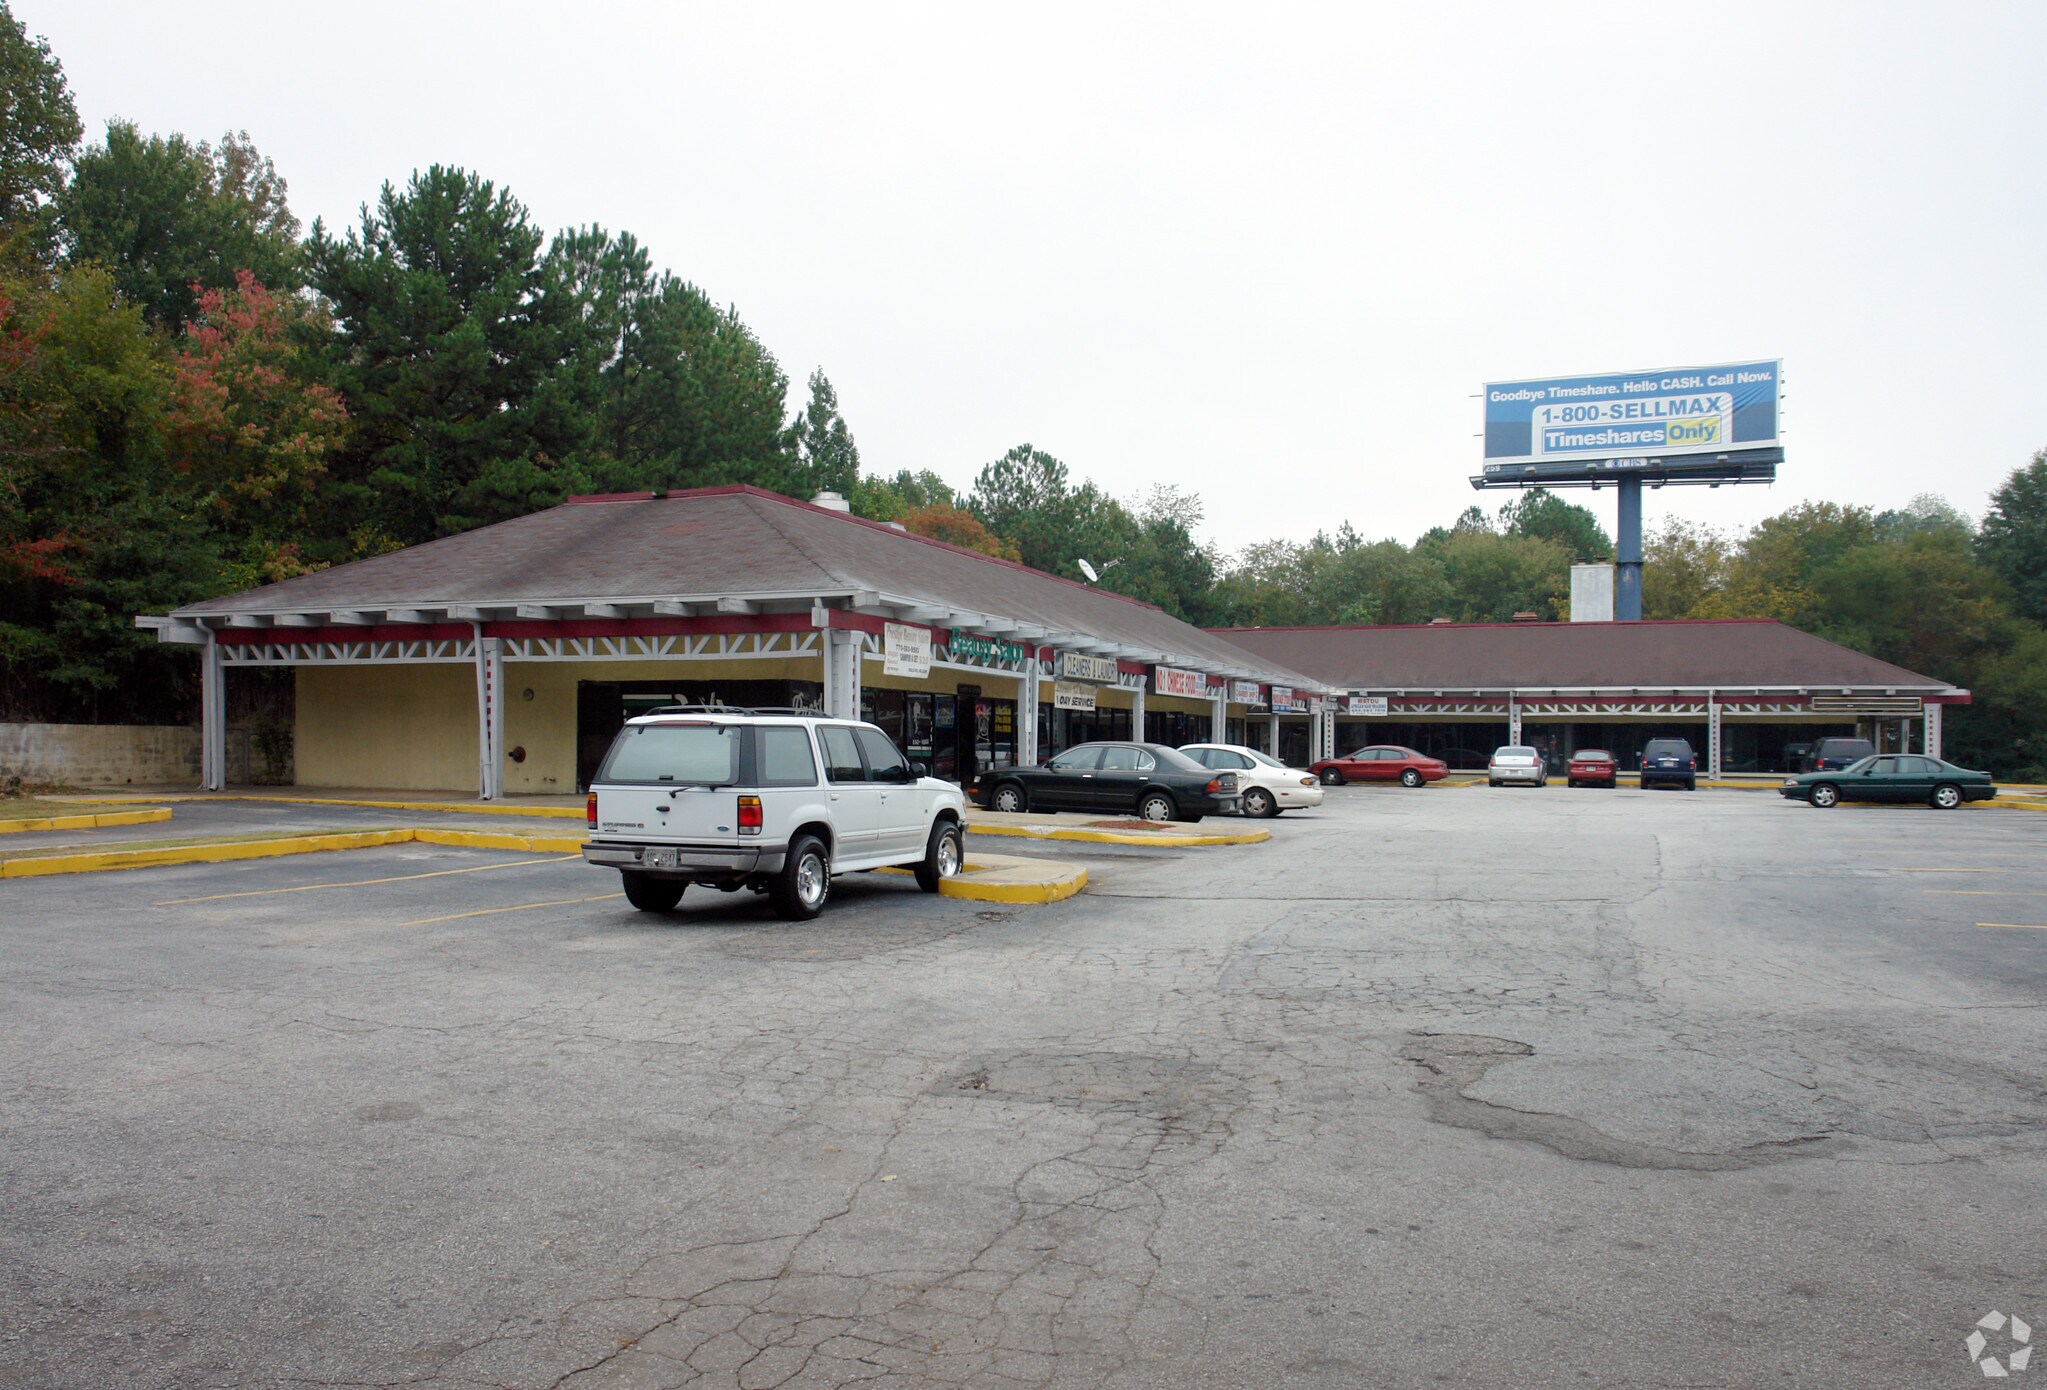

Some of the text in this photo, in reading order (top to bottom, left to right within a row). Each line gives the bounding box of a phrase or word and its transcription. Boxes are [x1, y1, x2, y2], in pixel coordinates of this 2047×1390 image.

[1490, 370, 1772, 404] Goodbye Timeshare. Hello CASH. Call Now.
[1541, 396, 1723, 423] 1-800-SELLMAX
[1546, 422, 1717, 448] Timeshares Only
[1621, 458, 1642, 467] CBS
[951, 628, 1025, 663] Beauty Salon
[1067, 656, 1091, 678] CLEANERS
[1097, 661, 1117, 681] LAUNDRY
[1059, 695, 1071, 706] DAY
[1071, 696, 1094, 708] SERVICE
